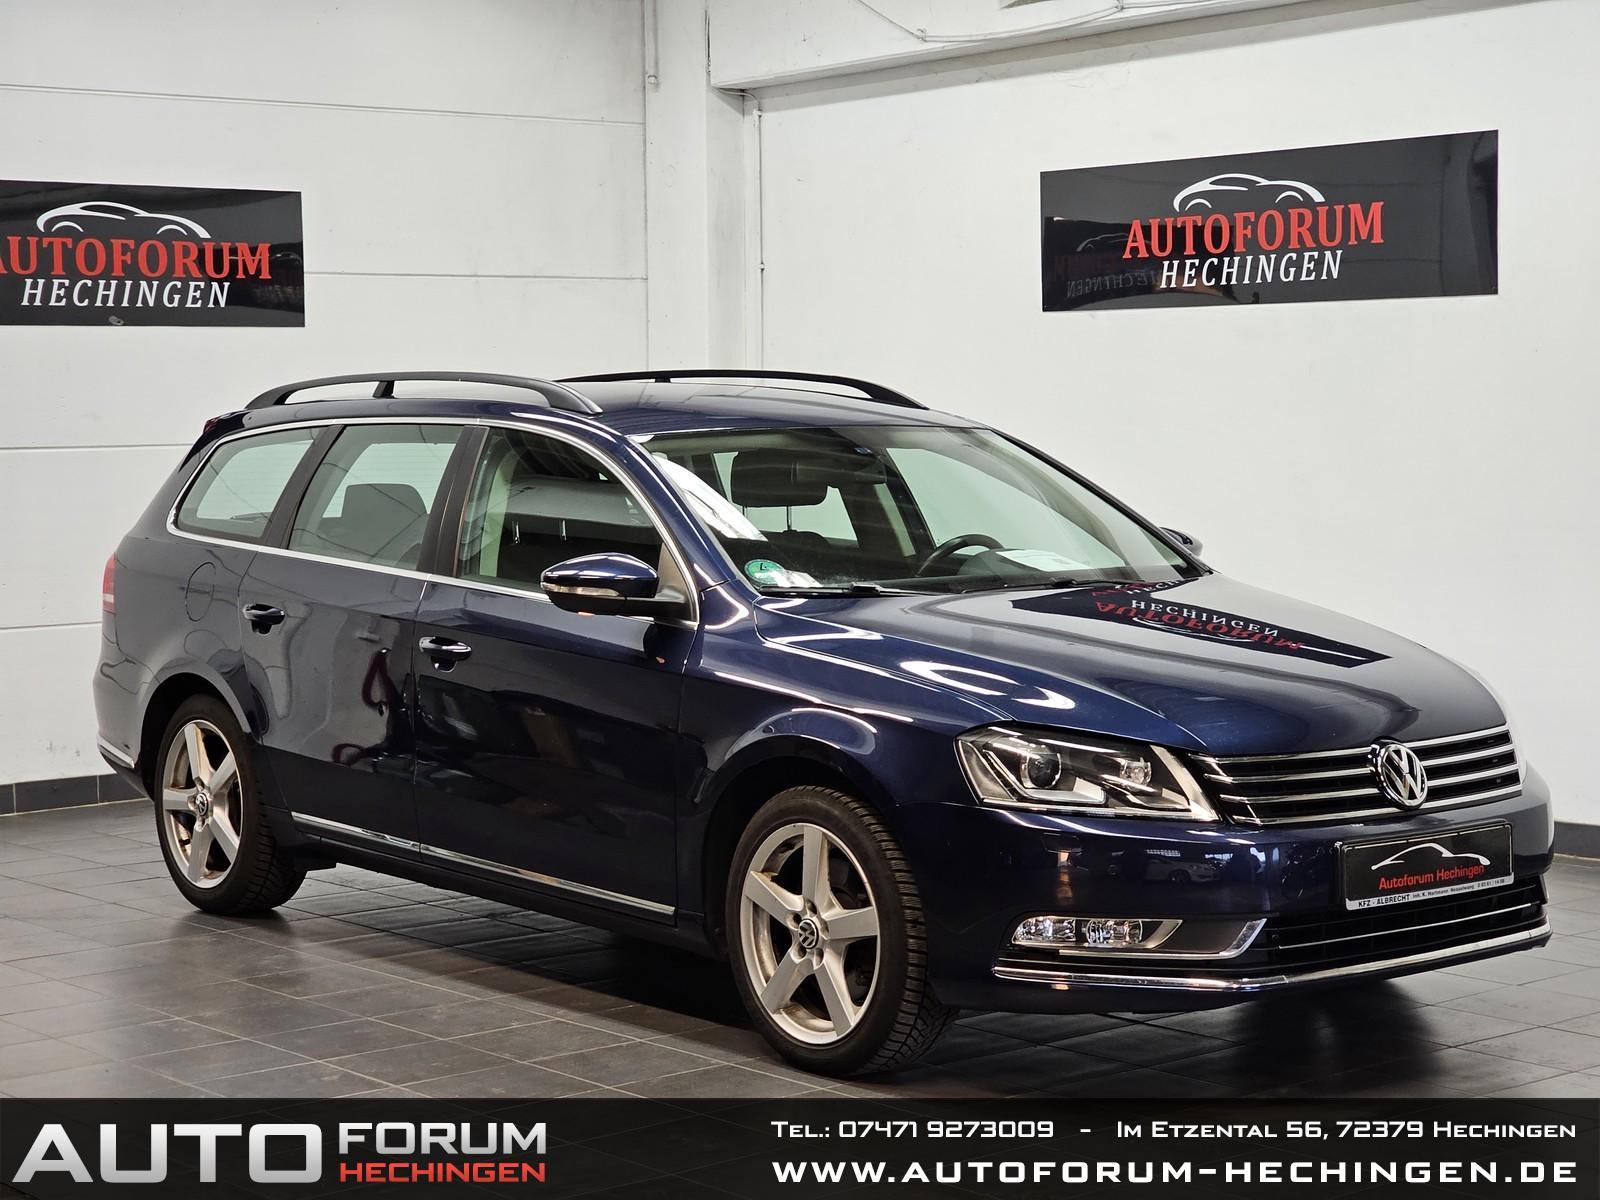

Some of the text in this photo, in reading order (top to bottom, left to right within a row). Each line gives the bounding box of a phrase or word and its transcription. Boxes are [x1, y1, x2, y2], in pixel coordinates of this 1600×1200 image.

[1122, 201, 1385, 260] AUTOFORUM
[0, 235, 272, 280] UTOFORUM
[1159, 249, 1344, 289] HECHINGEN
[20, 278, 231, 308] HECHINGEN
[1378, 864, 1485, 890] Autoforum Hechingen
[1358, 899, 1371, 908] KFZ
[1376, 893, 1411, 905] ALBRECHT
